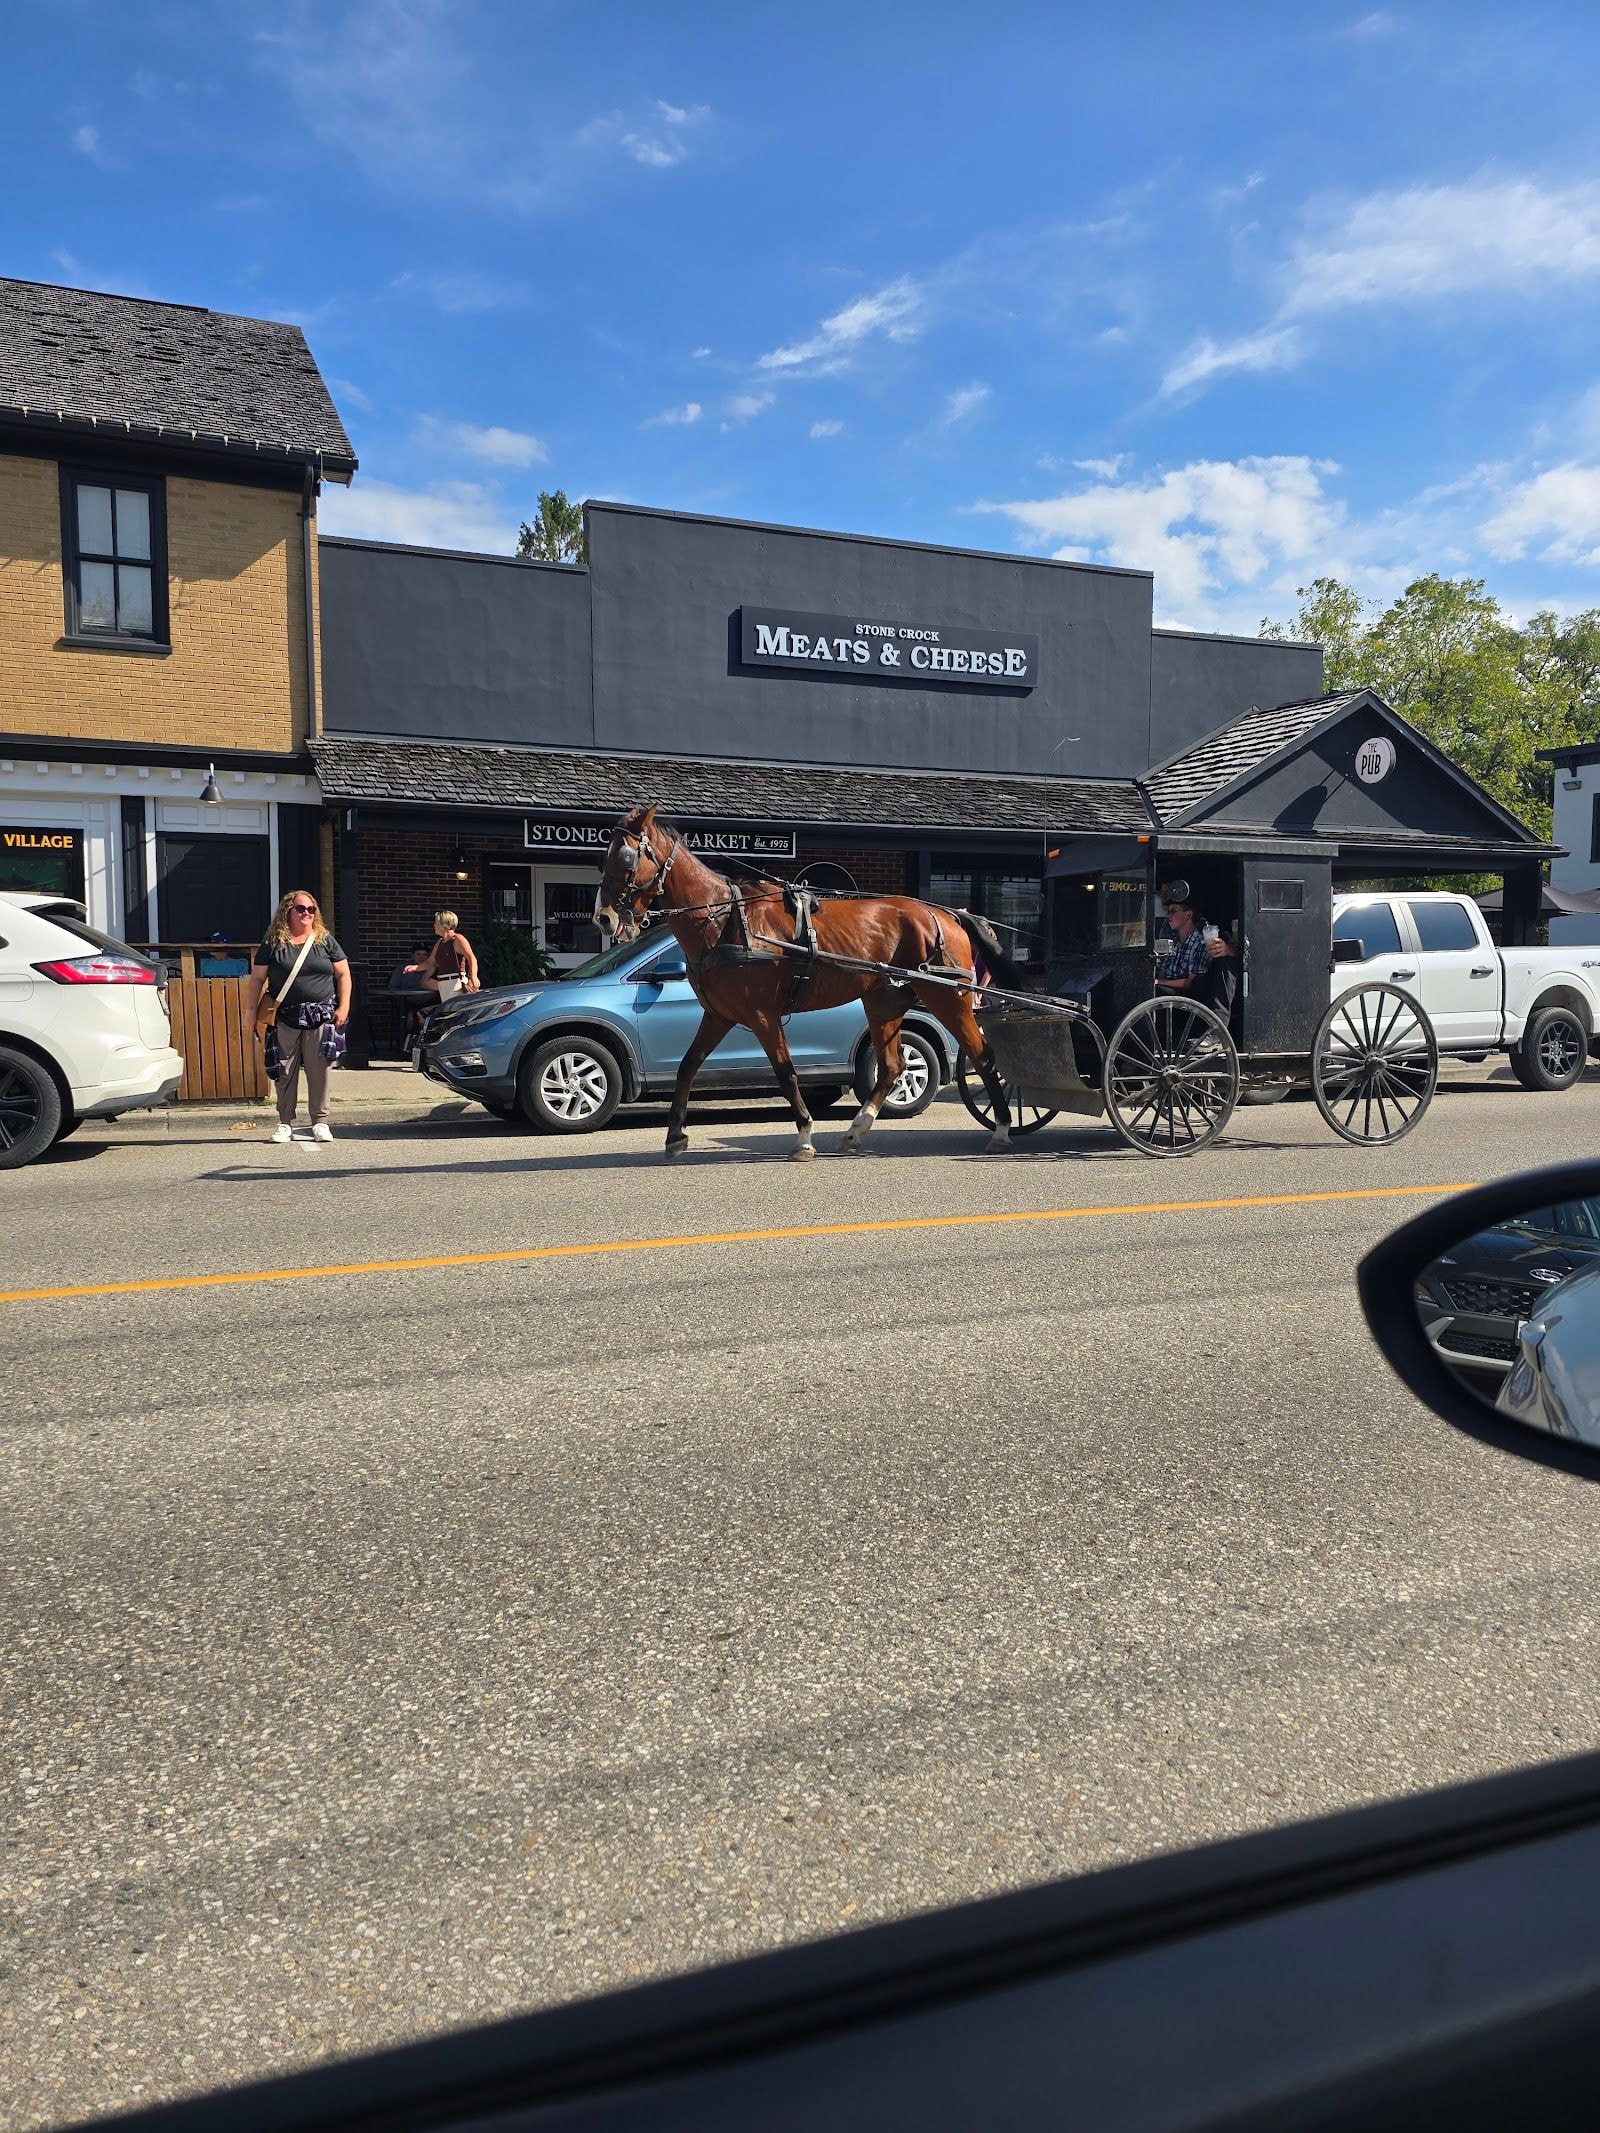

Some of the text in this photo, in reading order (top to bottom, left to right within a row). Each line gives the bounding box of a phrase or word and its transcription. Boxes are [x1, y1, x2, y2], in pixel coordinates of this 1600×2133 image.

[856, 624, 940, 642] STONE CROCK
[755, 624, 1028, 677] MEATS & CHEESE
[1368, 743, 1378, 753] THE
[1361, 754, 1381, 775] PUB
[3, 833, 74, 849] VILLAGE
[532, 825, 615, 844] STONEC
[770, 838, 789, 849] 1975
[553, 911, 593, 919] WELCOME
